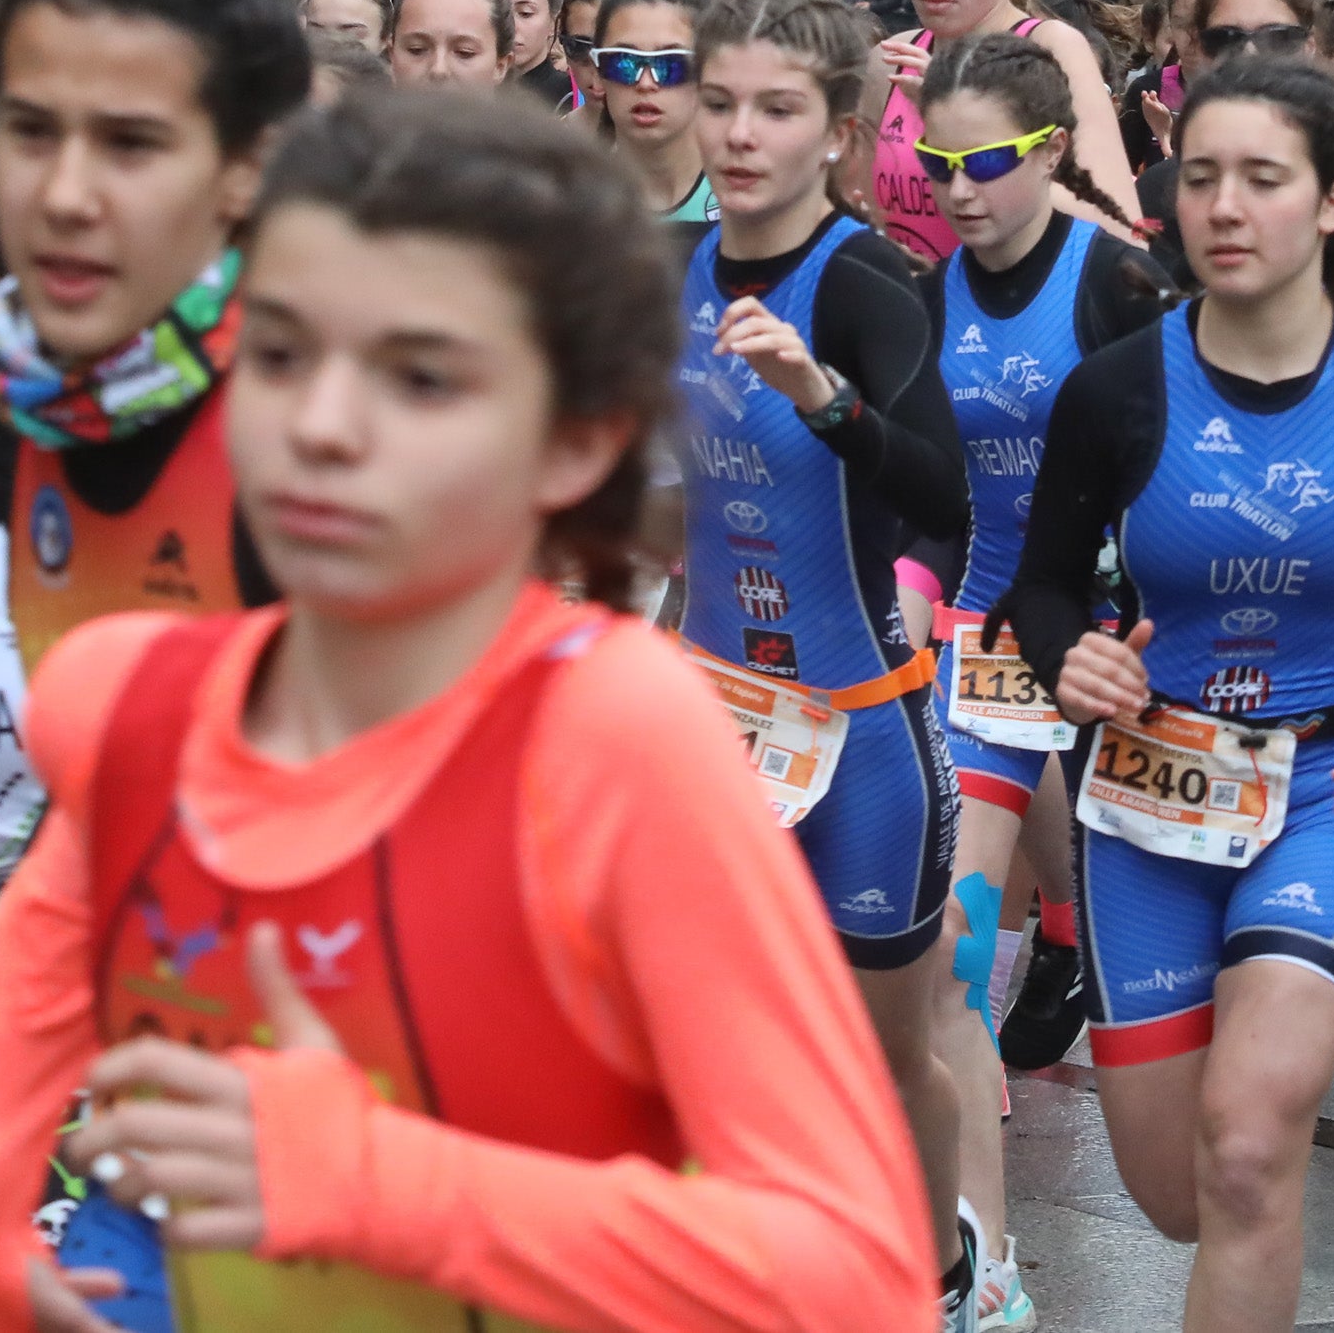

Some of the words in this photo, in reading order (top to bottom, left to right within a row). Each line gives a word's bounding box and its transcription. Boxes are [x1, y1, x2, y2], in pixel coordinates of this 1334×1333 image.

[953, 386, 981, 401] CLUB
[692, 434, 775, 488] NAHIA
[1190, 482, 1230, 508] CLUB
[1229, 497, 1293, 542] TRIATLON
[1210, 558, 1311, 595] UXUE
[986, 707, 1045, 720] ARANGUREN
[1094, 741, 1207, 804] 1240
